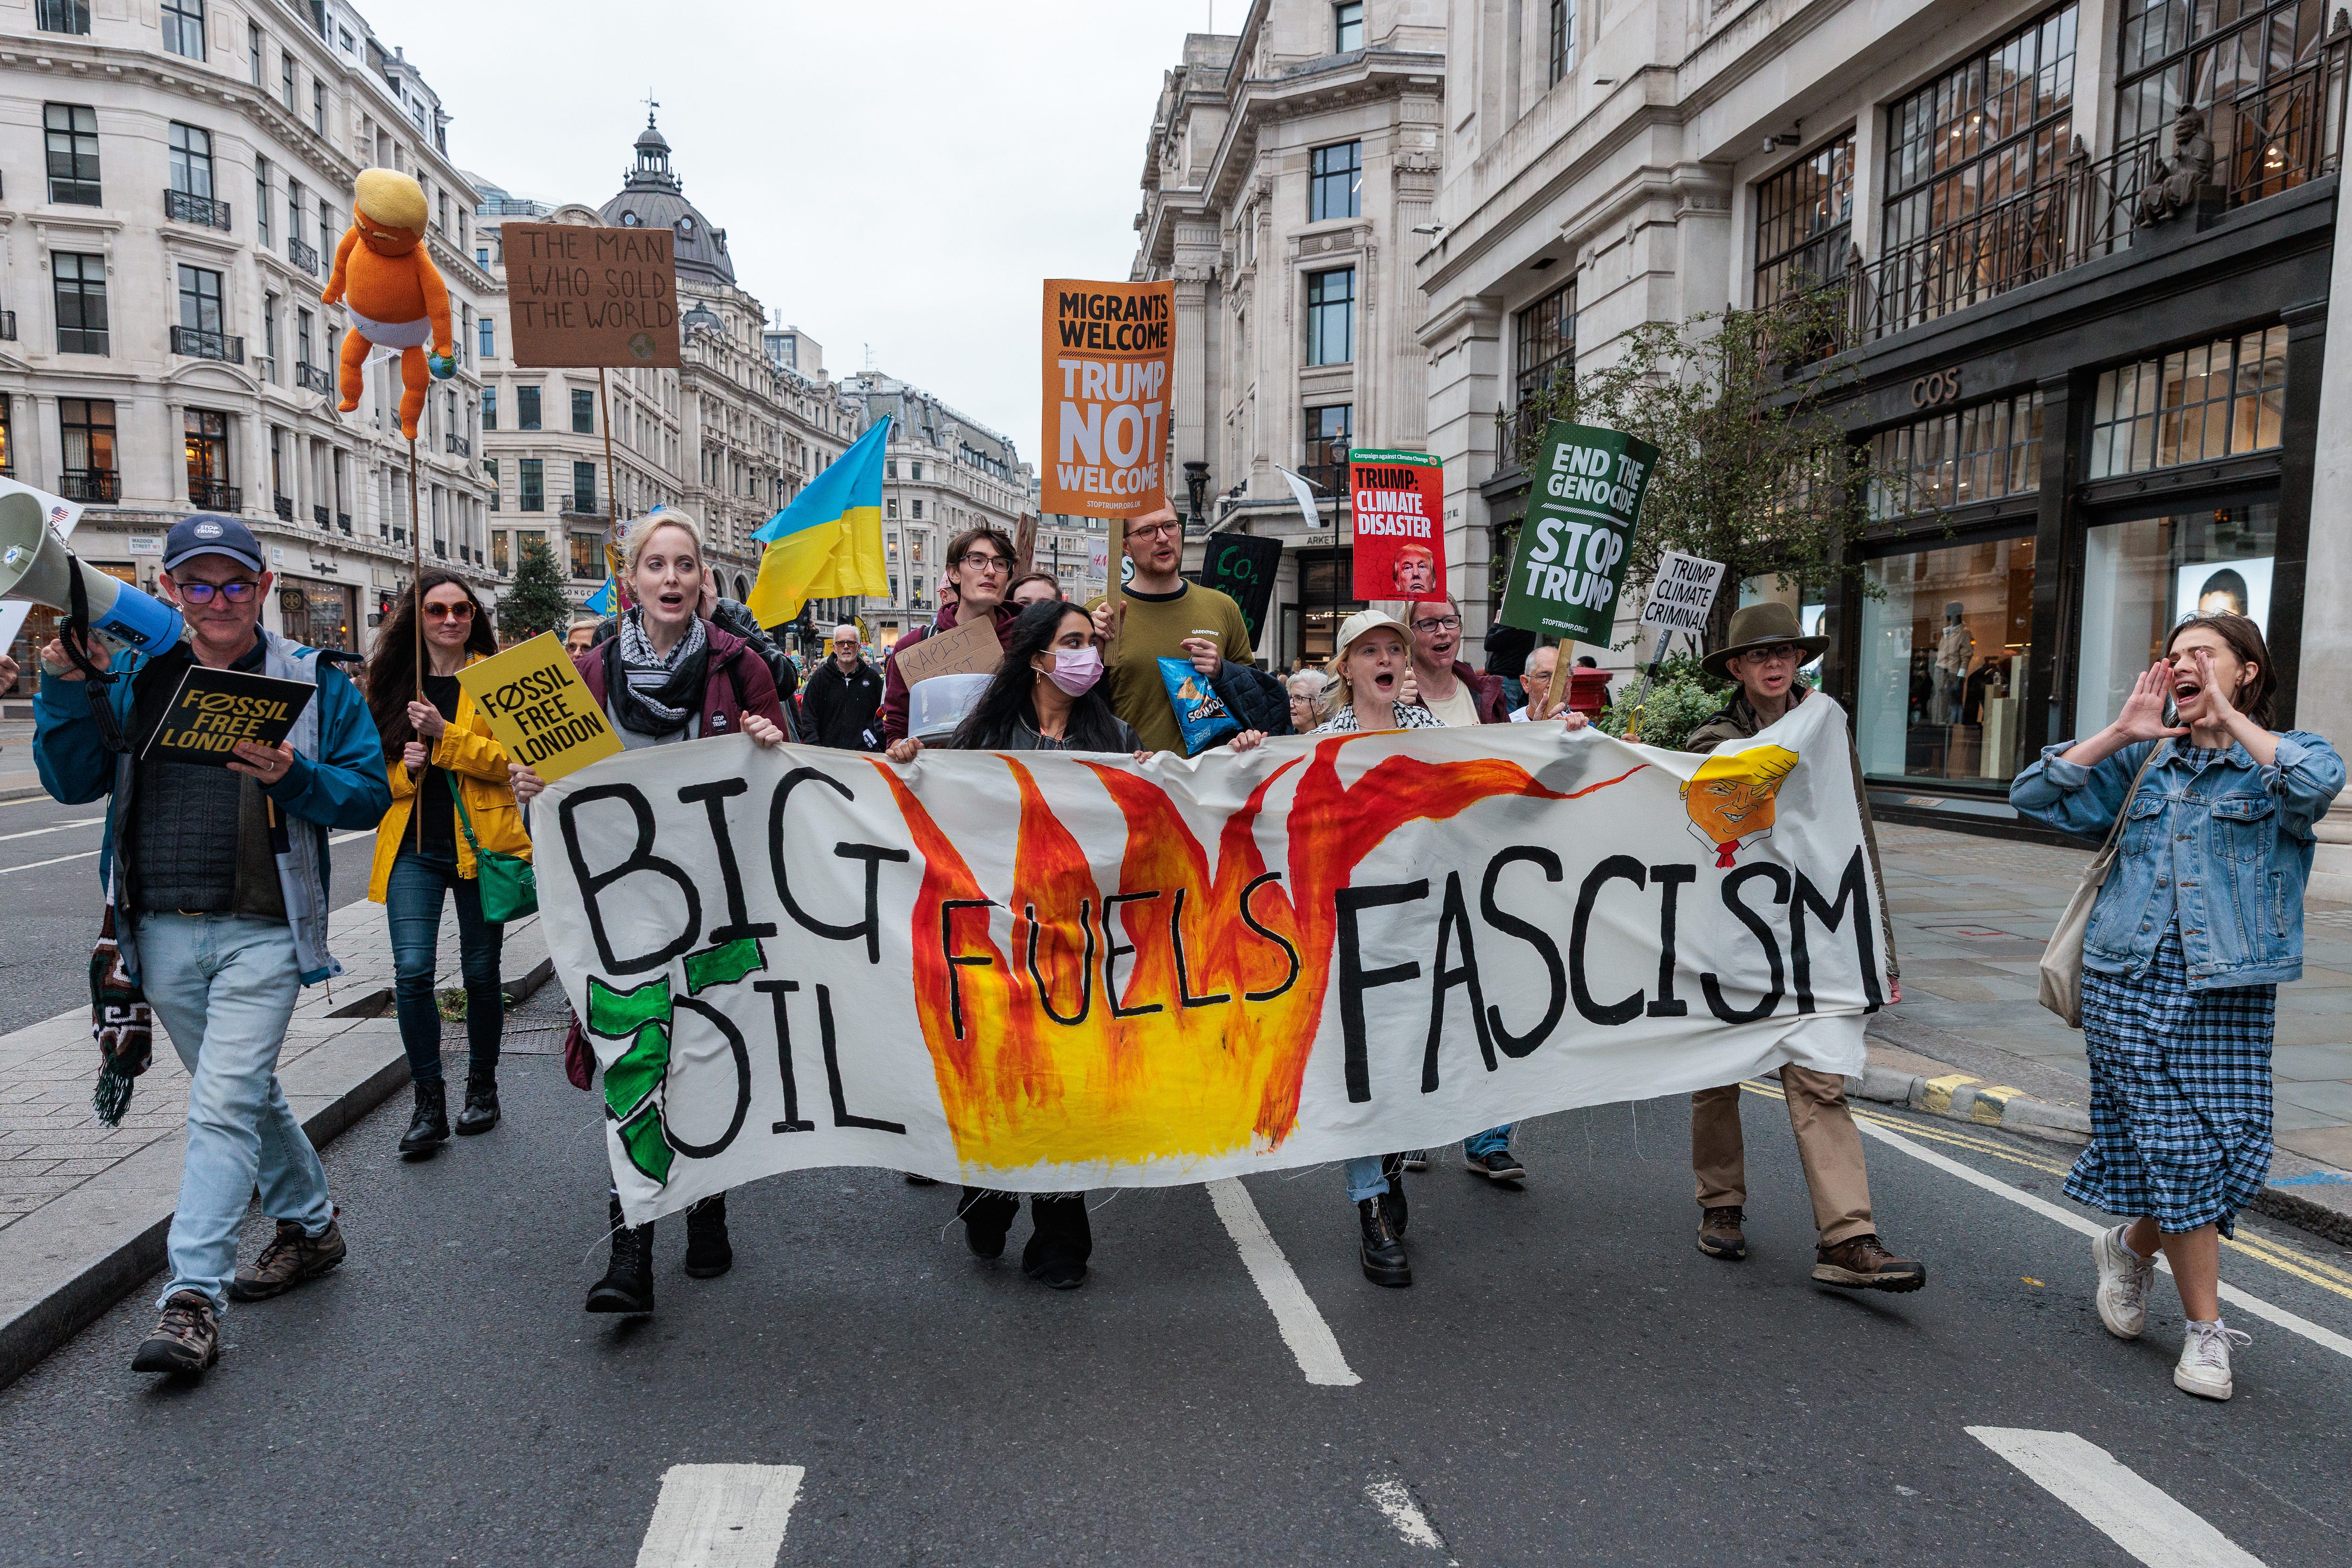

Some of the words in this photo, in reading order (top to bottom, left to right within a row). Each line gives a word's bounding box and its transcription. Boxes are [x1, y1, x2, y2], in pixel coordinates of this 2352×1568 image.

[520, 231, 579, 259] THE
[596, 232, 665, 264] MAN
[528, 264, 590, 297] WHO
[606, 266, 666, 299] SOLD
[514, 300, 576, 328] THE
[583, 300, 673, 329] WORLD
[1058, 292, 1168, 322] MIGRANTS
[1058, 320, 1168, 351] WELCOME
[1058, 359, 1166, 402] TRUMP
[1911, 367, 1957, 408] COS
[1059, 401, 1163, 468] NOT
[1057, 462, 1158, 495] WELCOME
[1355, 467, 1418, 491] TRUMP:
[1552, 443, 1610, 477] END
[1616, 453, 1644, 491] THE
[1086, 499, 1141, 510] STOPTRUMP.ORG.UK
[1357, 491, 1423, 515] CLIMATE
[1547, 473, 1636, 515] GENOCIDE
[1307, 535, 1336, 545] ARKET
[1357, 513, 1432, 538] DISASTER
[1529, 517, 1623, 576] STOP
[1526, 560, 1613, 612] TRUMP
[1671, 558, 1716, 584] TRUMP
[1657, 579, 1712, 607] CLIMATE
[1541, 618, 1589, 634] STOPTRUMP.ORG.UK
[1645, 601, 1706, 631] CRIMINAL
[903, 627, 973, 677] RAPIST
[181, 689, 288, 721] FØSSIL
[480, 663, 575, 719] FØSSIL
[191, 712, 265, 737] FREE
[512, 693, 575, 736] FREE
[1187, 696, 1225, 723] Doritos
[512, 711, 605, 767] LONDON
[1194, 729, 1210, 741] CRUNCH
[1196, 732, 1211, 744] BOLDER
[558, 765, 910, 976] BIG
[941, 871, 1299, 1040] FUELS
[1335, 845, 1885, 1104] FASCISM
[661, 979, 907, 1159] OIL
